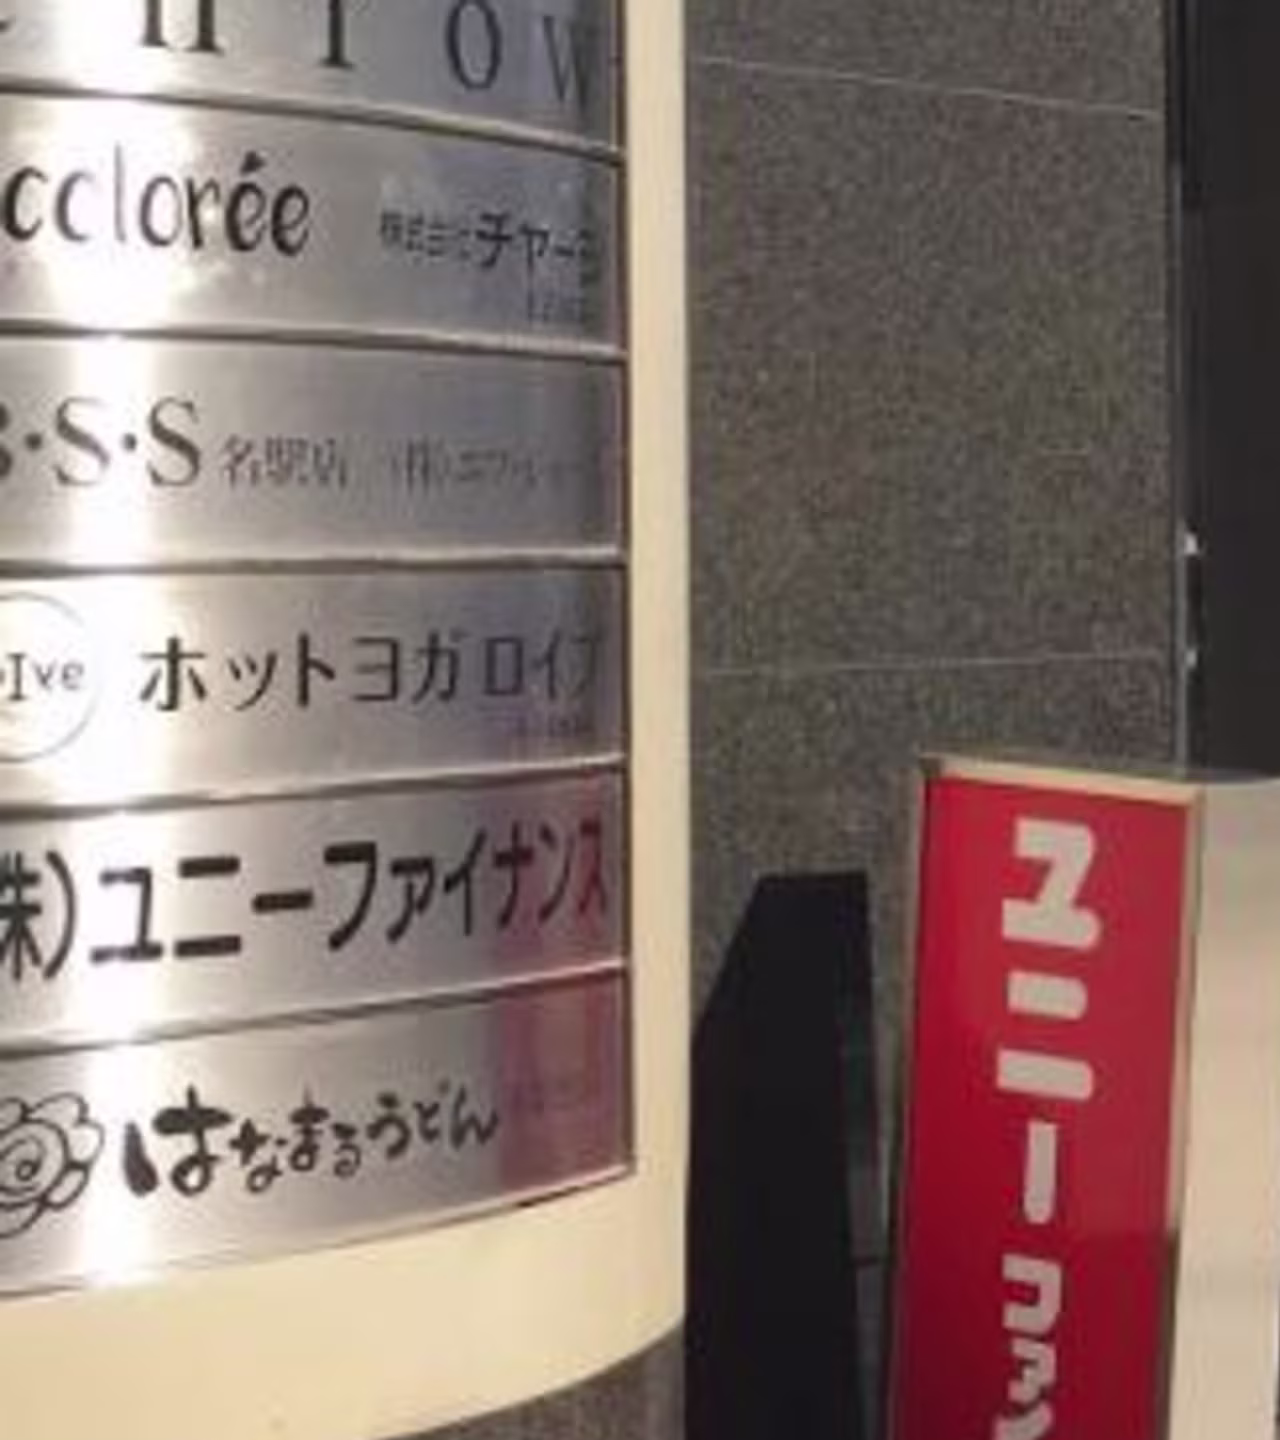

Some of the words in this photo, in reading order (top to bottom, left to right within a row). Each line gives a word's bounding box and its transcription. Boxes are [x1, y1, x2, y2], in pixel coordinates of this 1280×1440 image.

[121, 1085, 500, 1197] はなまるうどん
